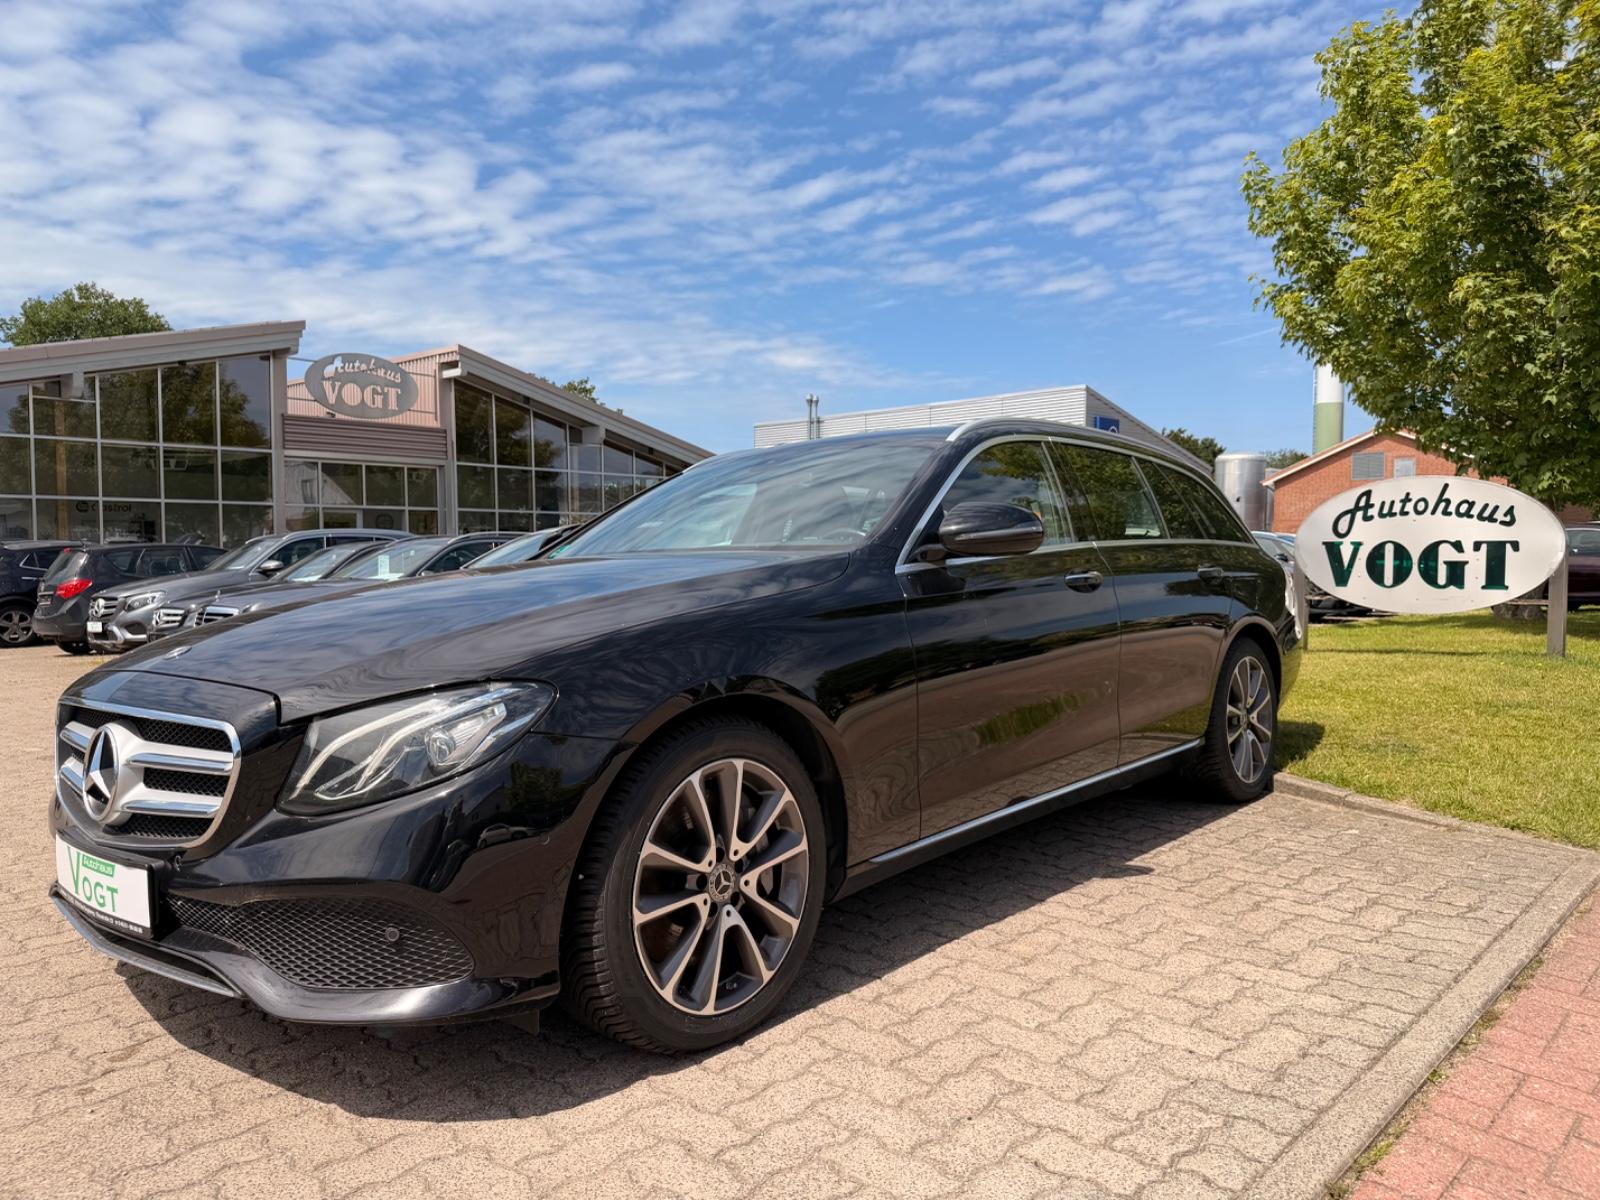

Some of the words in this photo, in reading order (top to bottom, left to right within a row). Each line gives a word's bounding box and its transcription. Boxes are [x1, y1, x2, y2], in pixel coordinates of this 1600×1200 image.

[321, 380, 402, 410] VOGT
[1331, 483, 1517, 539] Autohaus
[1321, 539, 1520, 590] VOGT
[66, 845, 118, 913] VOGT
